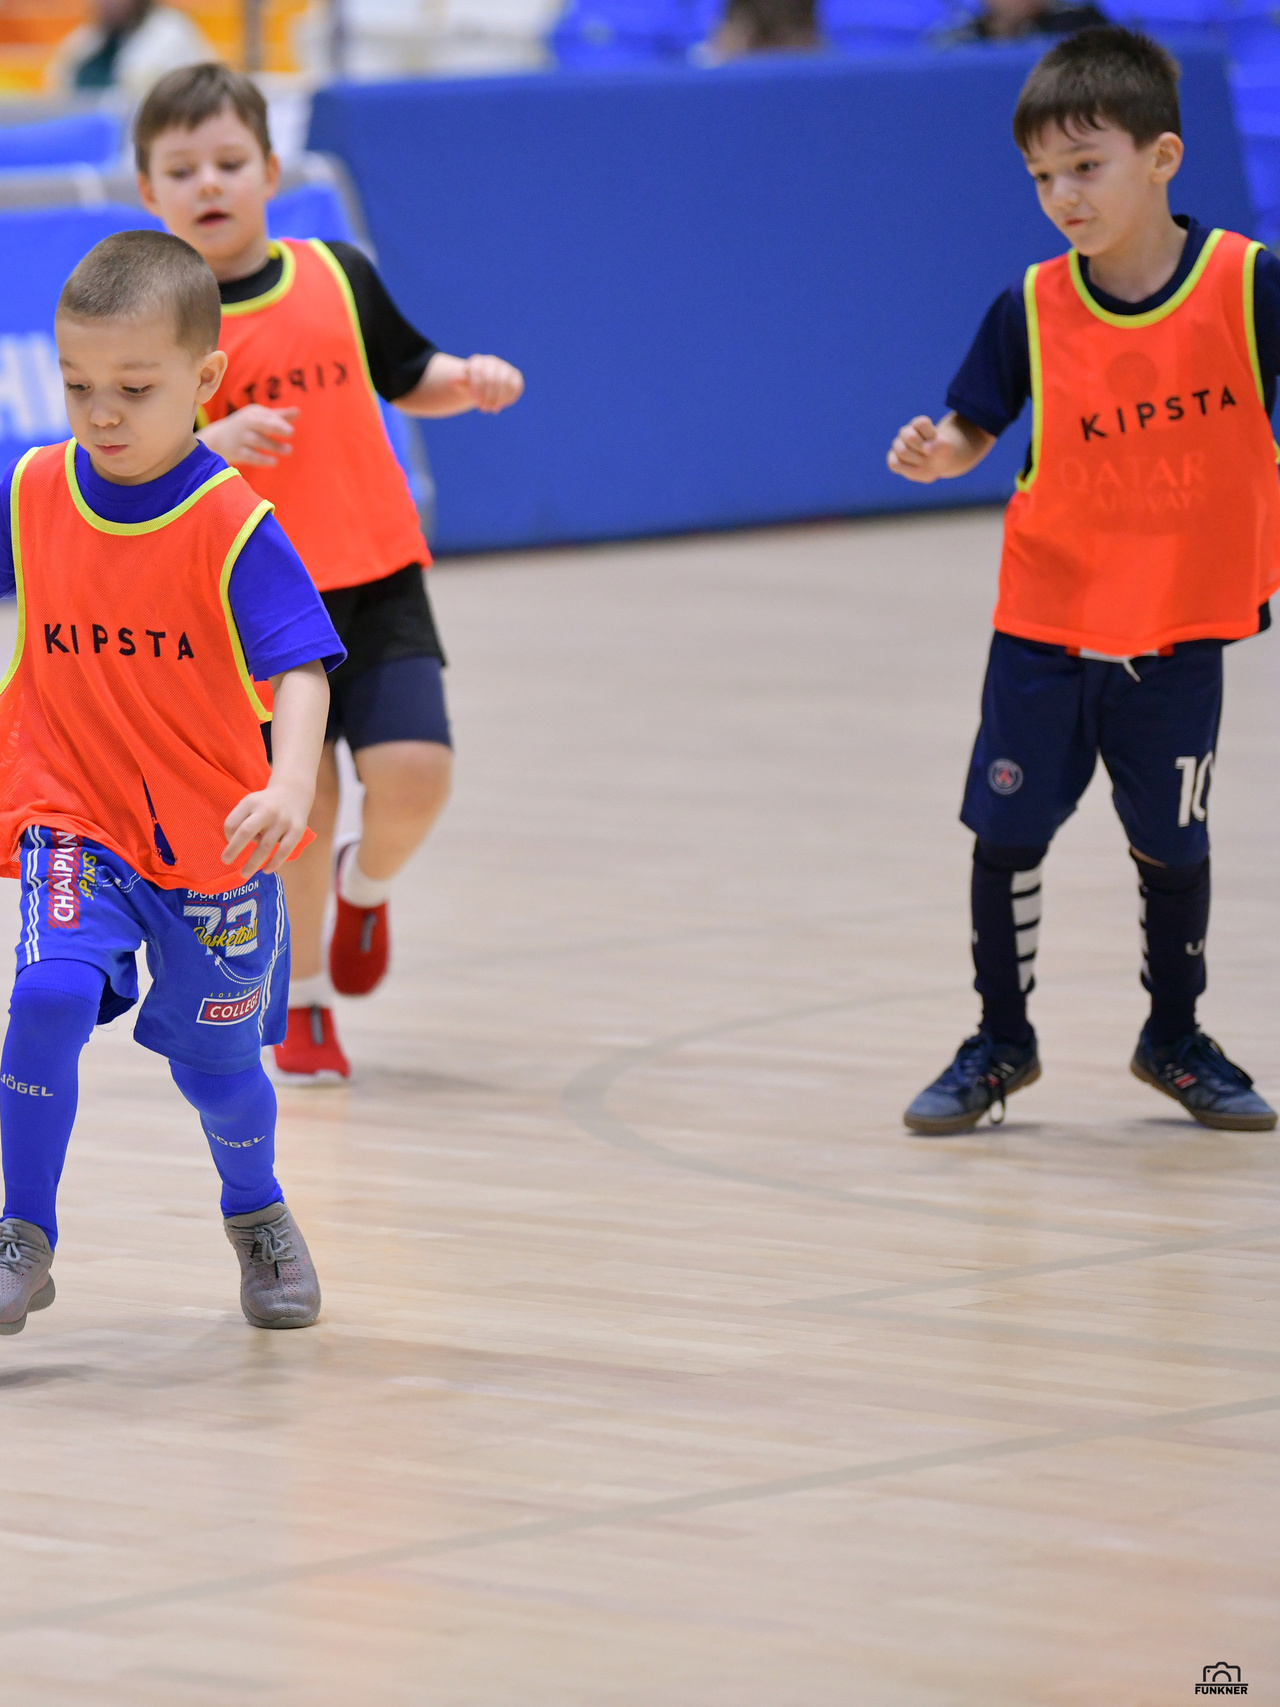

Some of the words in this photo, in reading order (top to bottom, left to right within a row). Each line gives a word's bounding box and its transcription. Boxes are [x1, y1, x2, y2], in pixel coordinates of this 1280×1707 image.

[1081, 386, 1236, 442] KIPSTA
[1059, 452, 1206, 494] QATAR
[44, 623, 195, 661] KIPSTA
[1174, 750, 1212, 828] 10
[222, 880, 259, 901] DIVISION
[193, 918, 258, 947] Basketball
